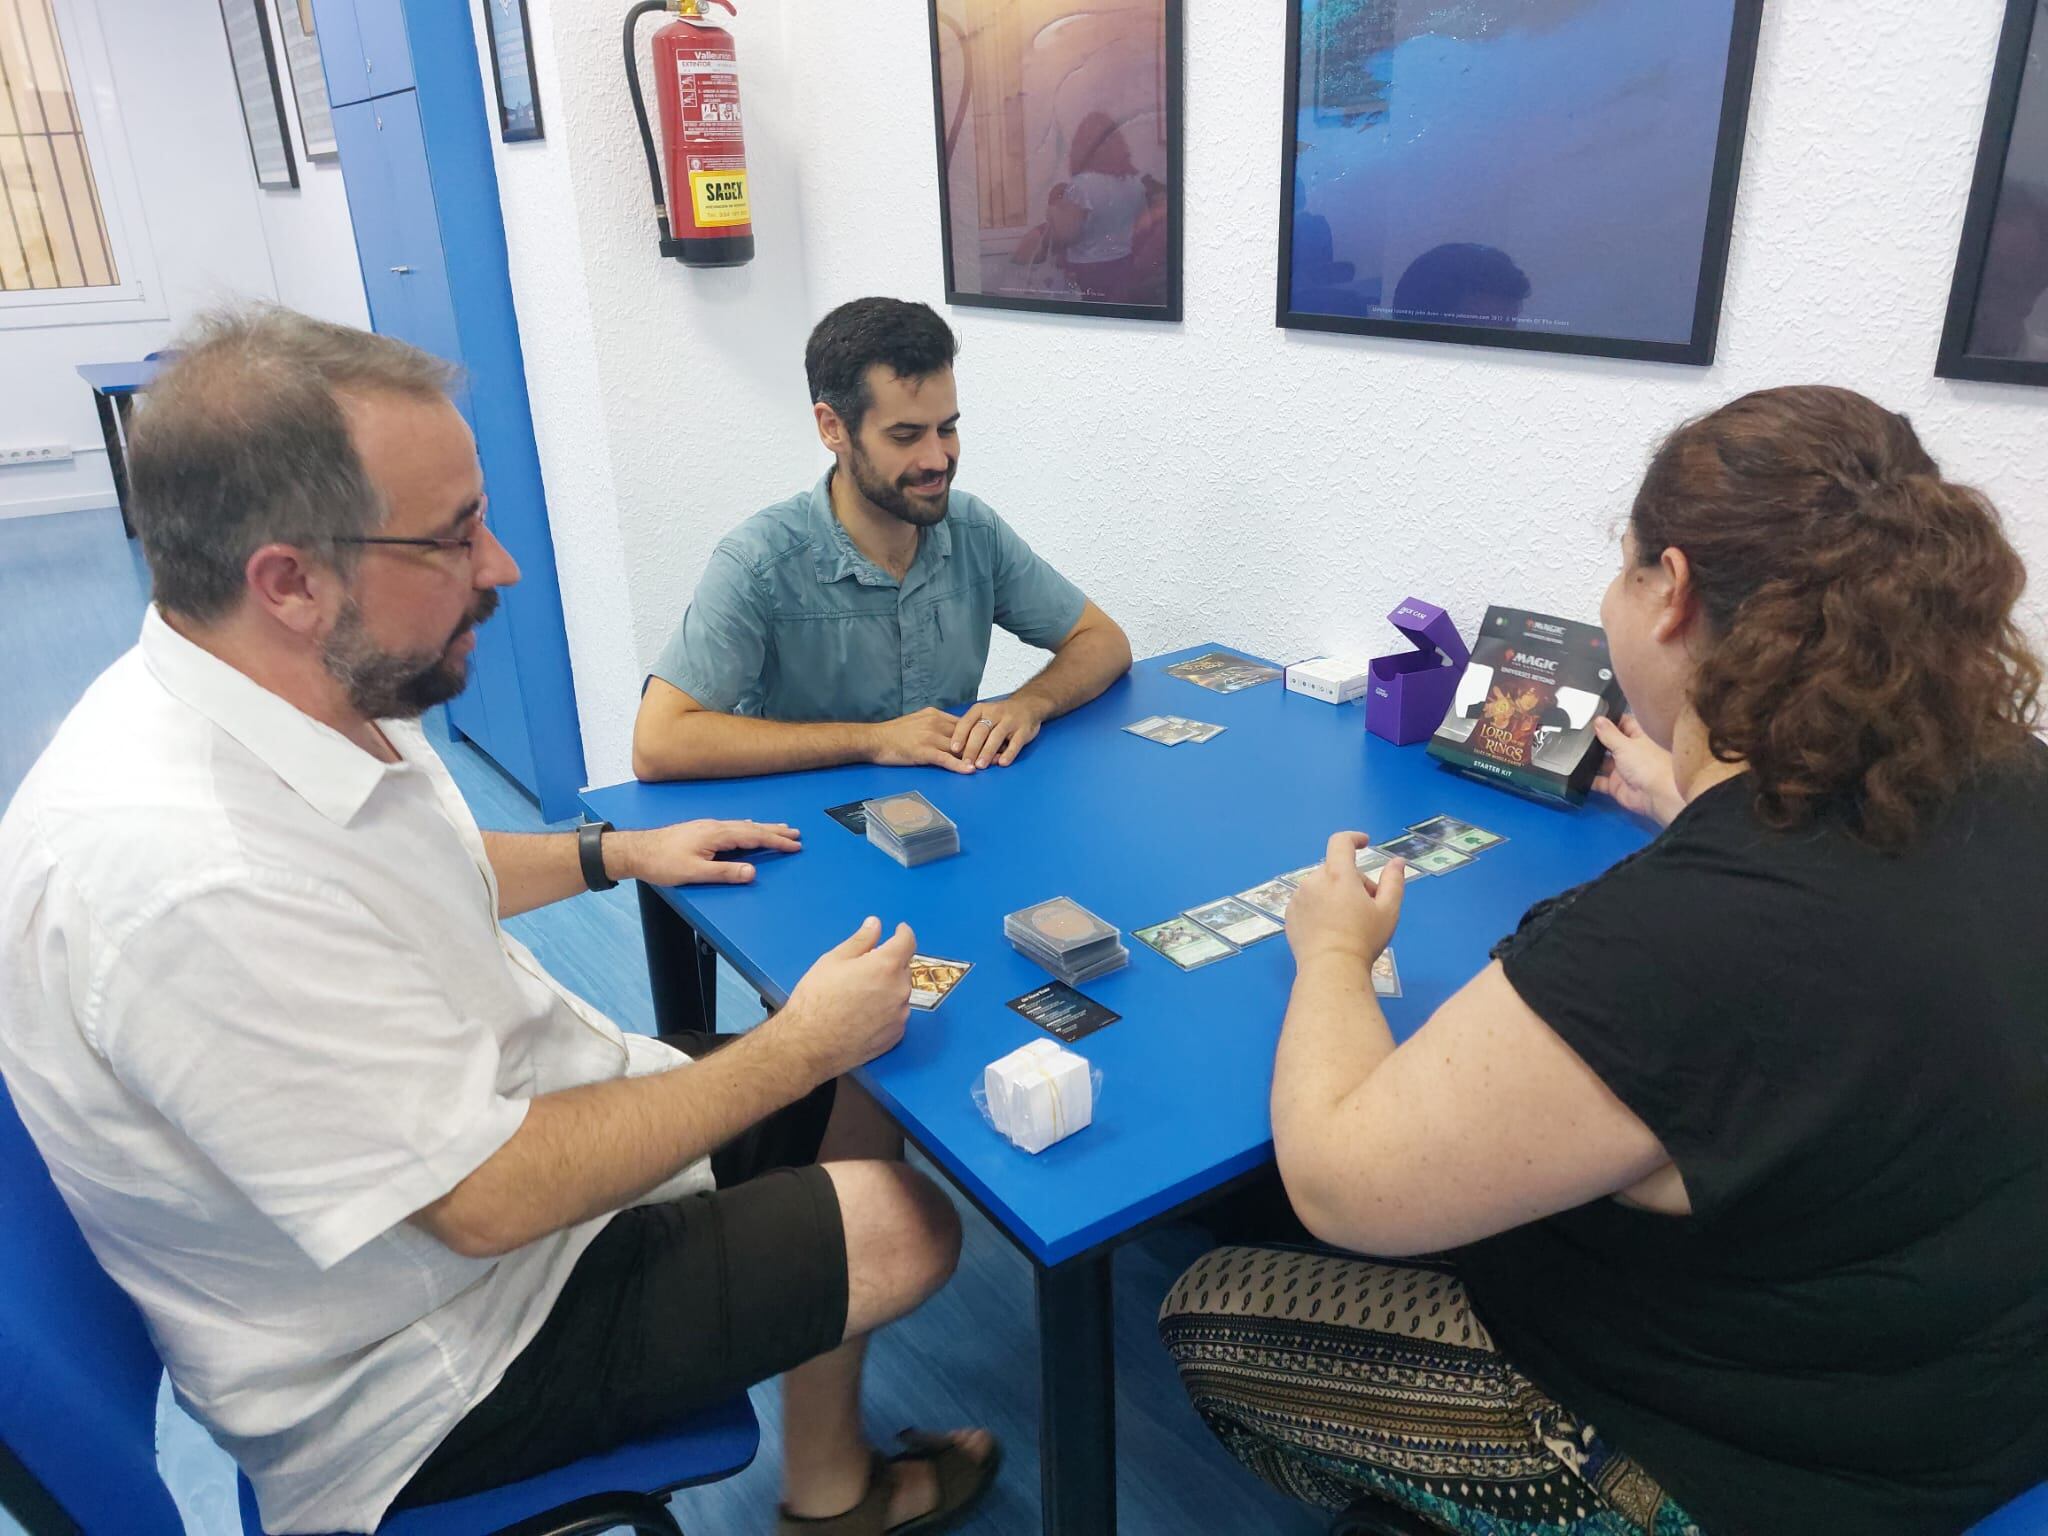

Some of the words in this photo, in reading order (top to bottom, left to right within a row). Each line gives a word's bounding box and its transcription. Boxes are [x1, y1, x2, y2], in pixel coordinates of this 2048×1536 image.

[705, 182, 743, 201] SADEX
[1413, 610, 1428, 620] CASE
[1534, 621, 1567, 635] MAGIC
[1512, 652, 1559, 671] MAGIC
[1480, 724, 1513, 743] LORD
[1486, 738, 1524, 761] RINGS
[1473, 760, 1501, 774] STARTER
[1500, 769, 1513, 777] KIT
